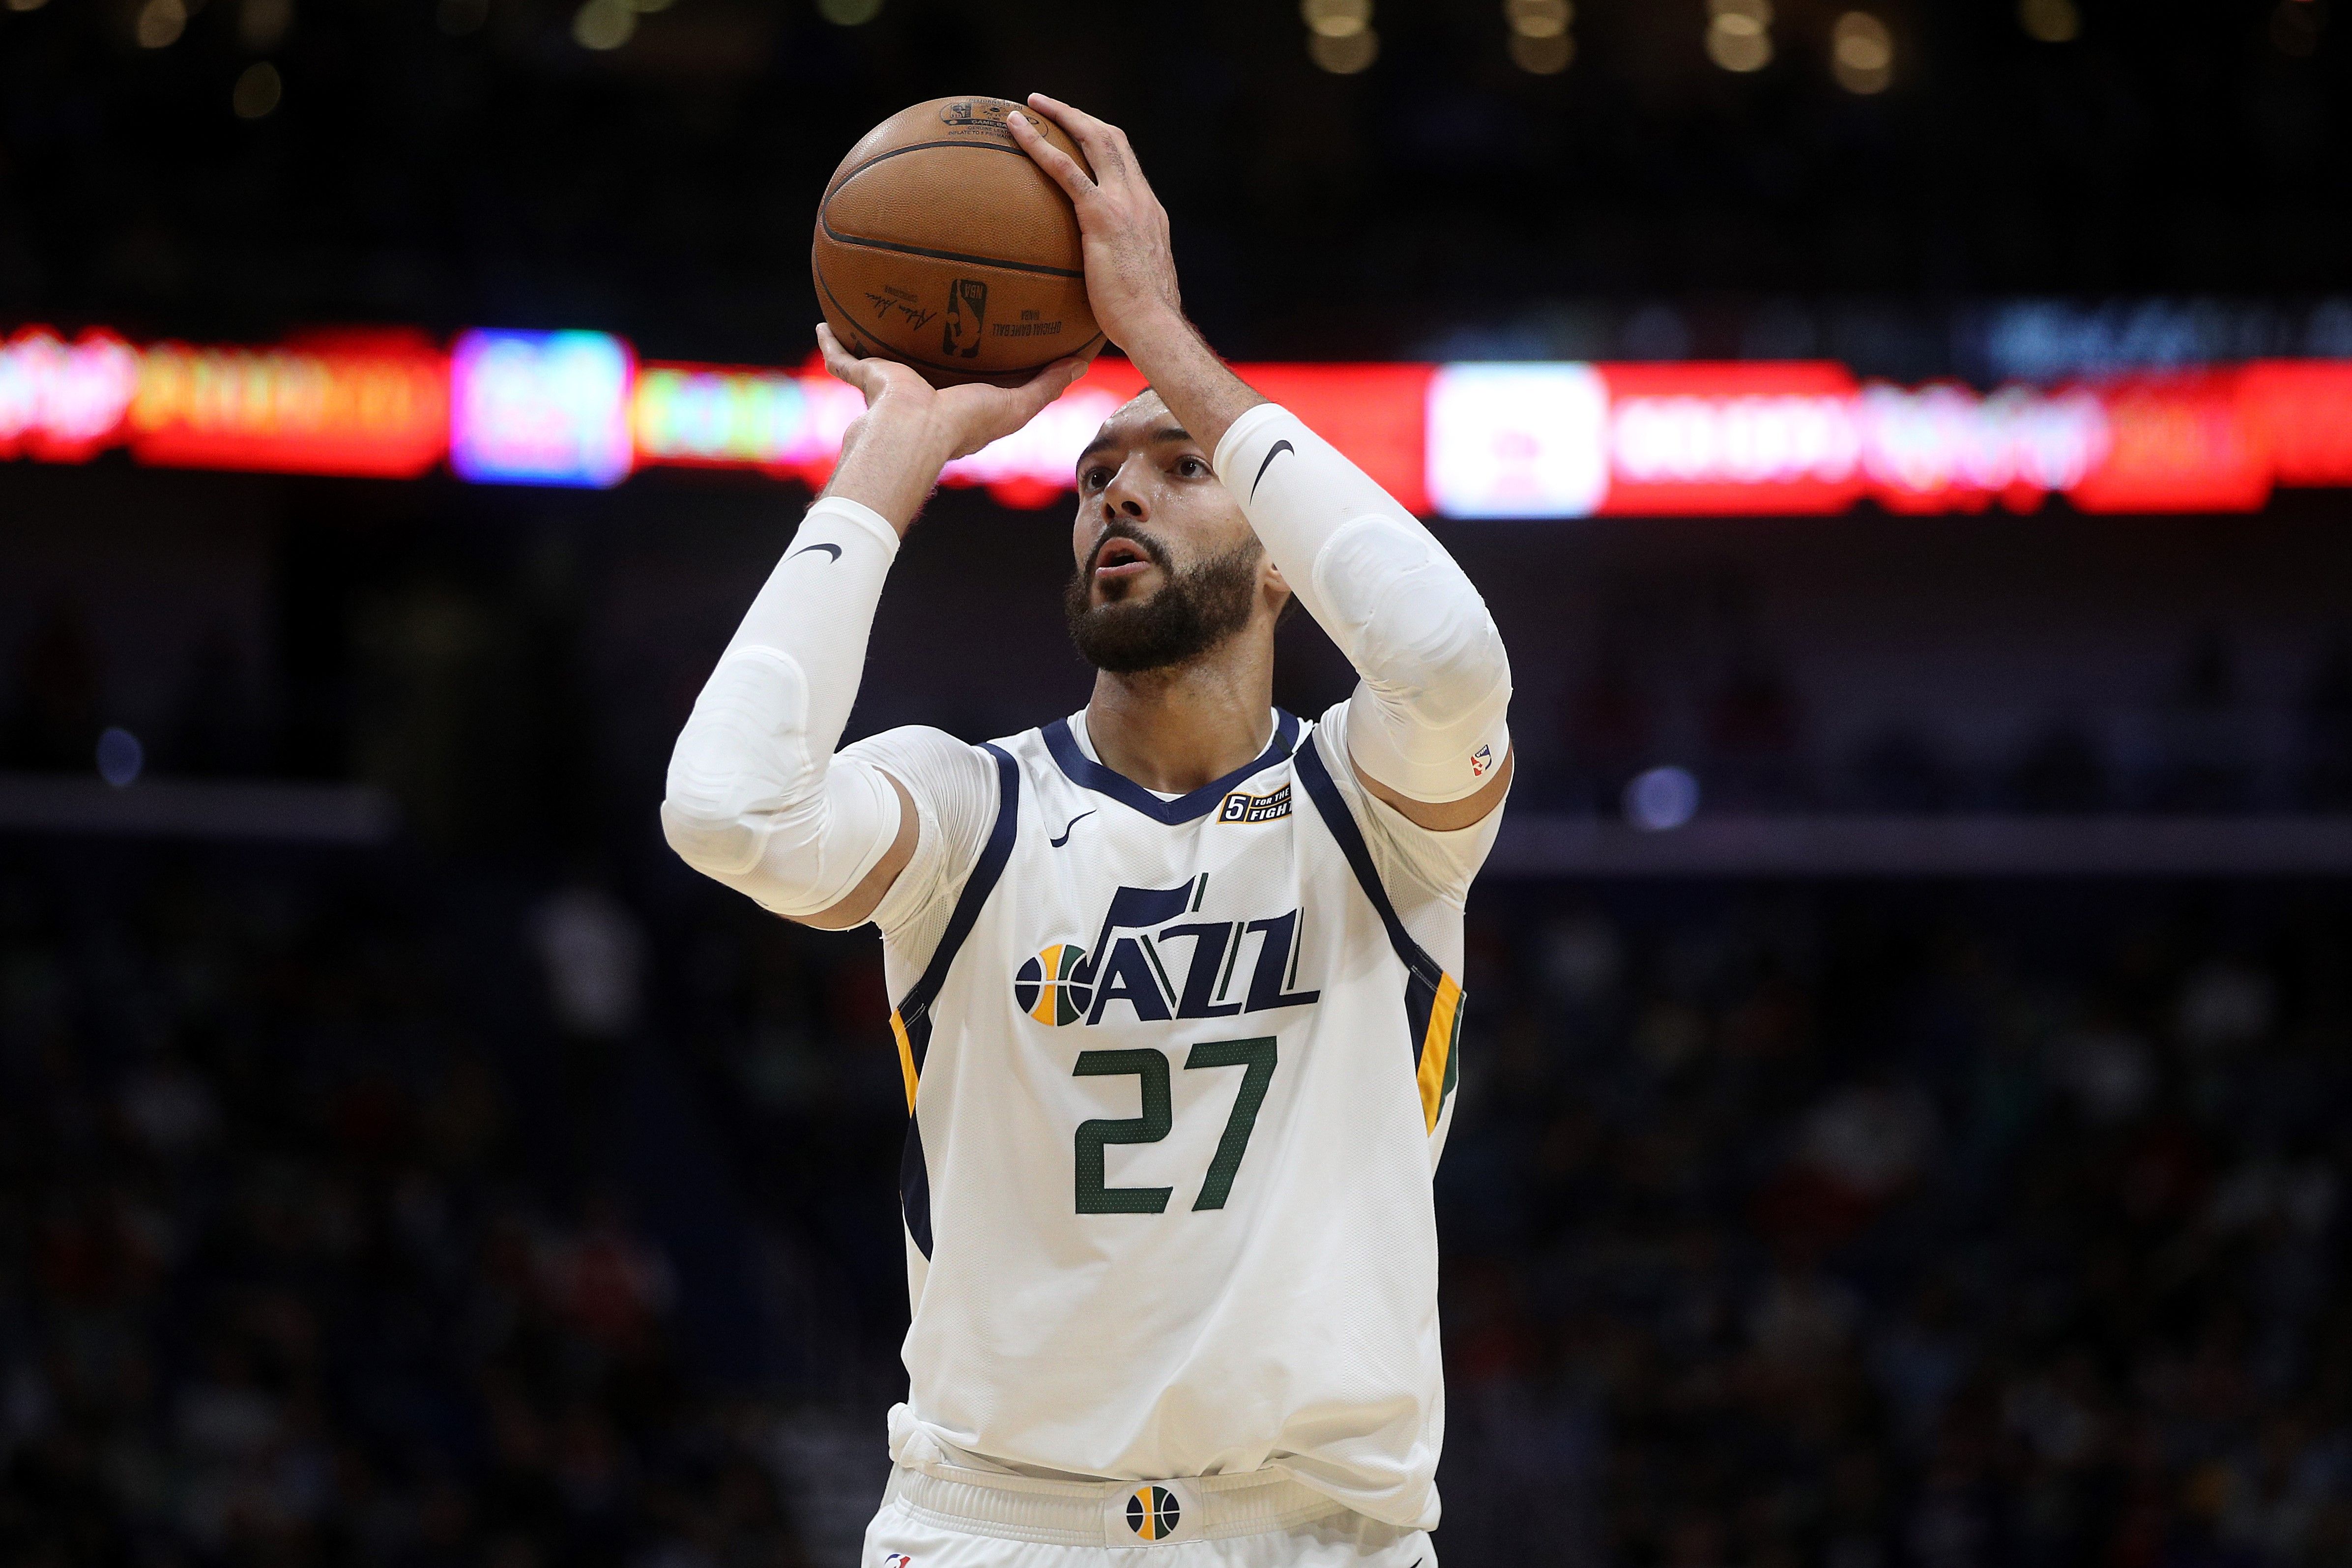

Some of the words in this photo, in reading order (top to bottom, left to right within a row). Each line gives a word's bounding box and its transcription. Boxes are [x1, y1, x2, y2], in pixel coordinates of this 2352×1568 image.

[965, 284, 983, 299] NBA
[993, 323, 1010, 337] BALL
[1010, 324, 1032, 336] GAME
[1033, 321, 1062, 336] OFFICIAL
[1255, 797, 1273, 806] FOR
[1275, 787, 1290, 802] THE
[1225, 795, 1247, 819] 5
[1072, 1035, 1278, 1214] 27
